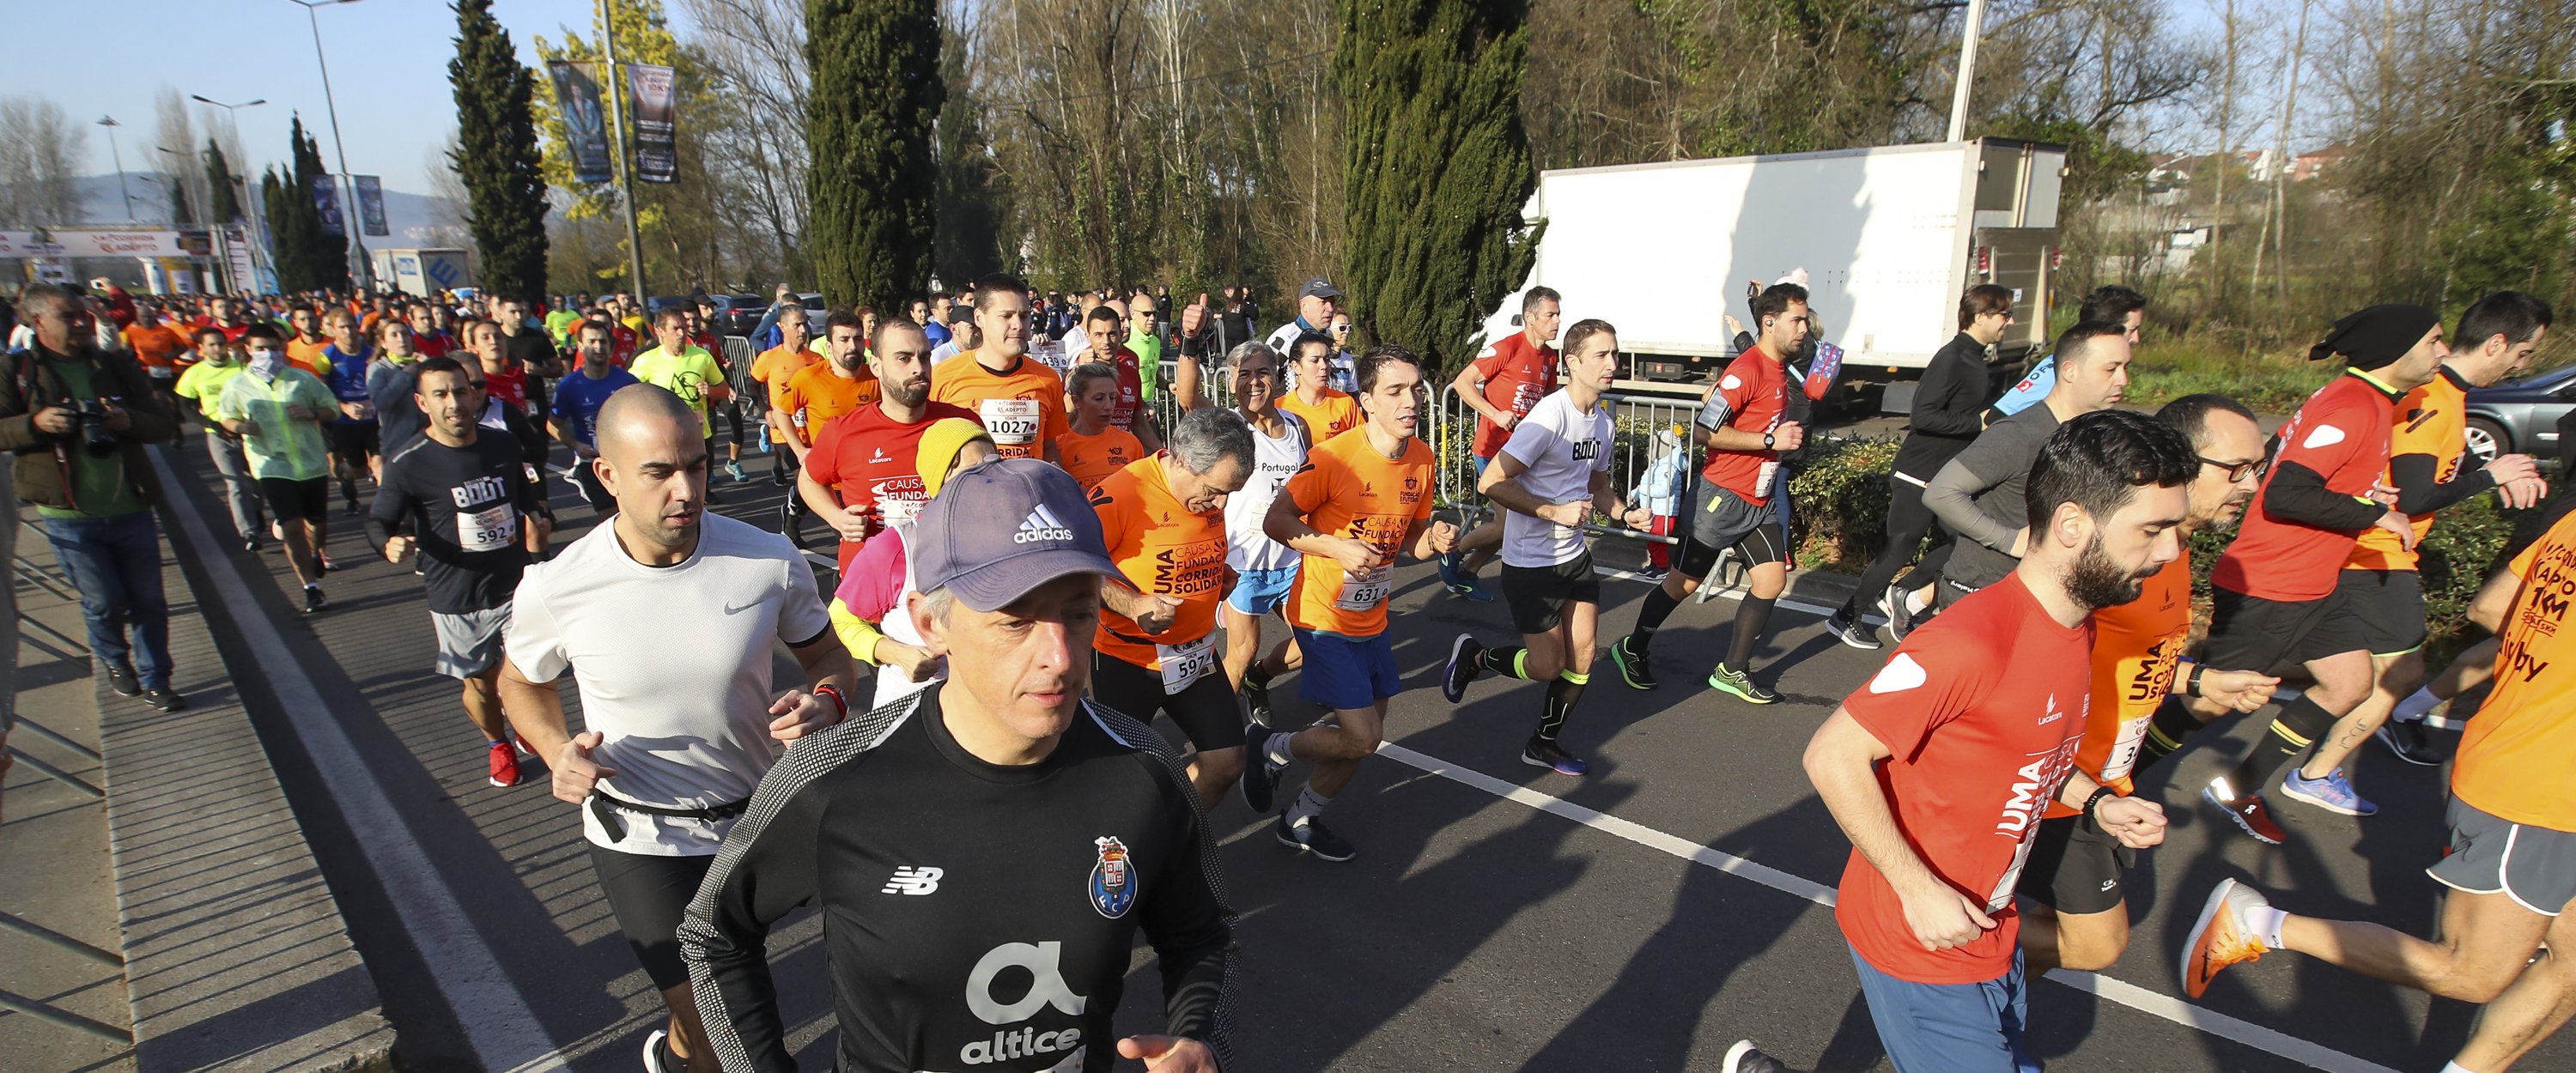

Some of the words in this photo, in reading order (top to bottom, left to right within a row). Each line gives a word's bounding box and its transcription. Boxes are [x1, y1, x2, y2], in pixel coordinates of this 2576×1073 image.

[1042, 356, 1060, 367] 439
[991, 421, 1030, 433] 1027
[998, 447, 1030, 458] RRIDA
[1261, 463, 1299, 475] Portugal
[887, 478, 926, 490] CAUSA
[888, 490, 931, 500] FUNDA
[1349, 517, 1367, 539] MA
[1368, 517, 1396, 527] CAUSA
[477, 527, 507, 543] 592
[1013, 527, 1074, 544] adidas
[1364, 529, 1403, 541] FUNDAÇ
[1175, 543, 1212, 558] CAUSA
[1153, 549, 1175, 594] UMA
[1174, 575, 1222, 594] SOLIDÁR
[1354, 588, 1380, 602] 631
[1178, 655, 1205, 678] 597
[2128, 639, 2167, 701] UMA
[1996, 756, 2046, 833] UMA
[960, 1027, 1081, 1065] altice
